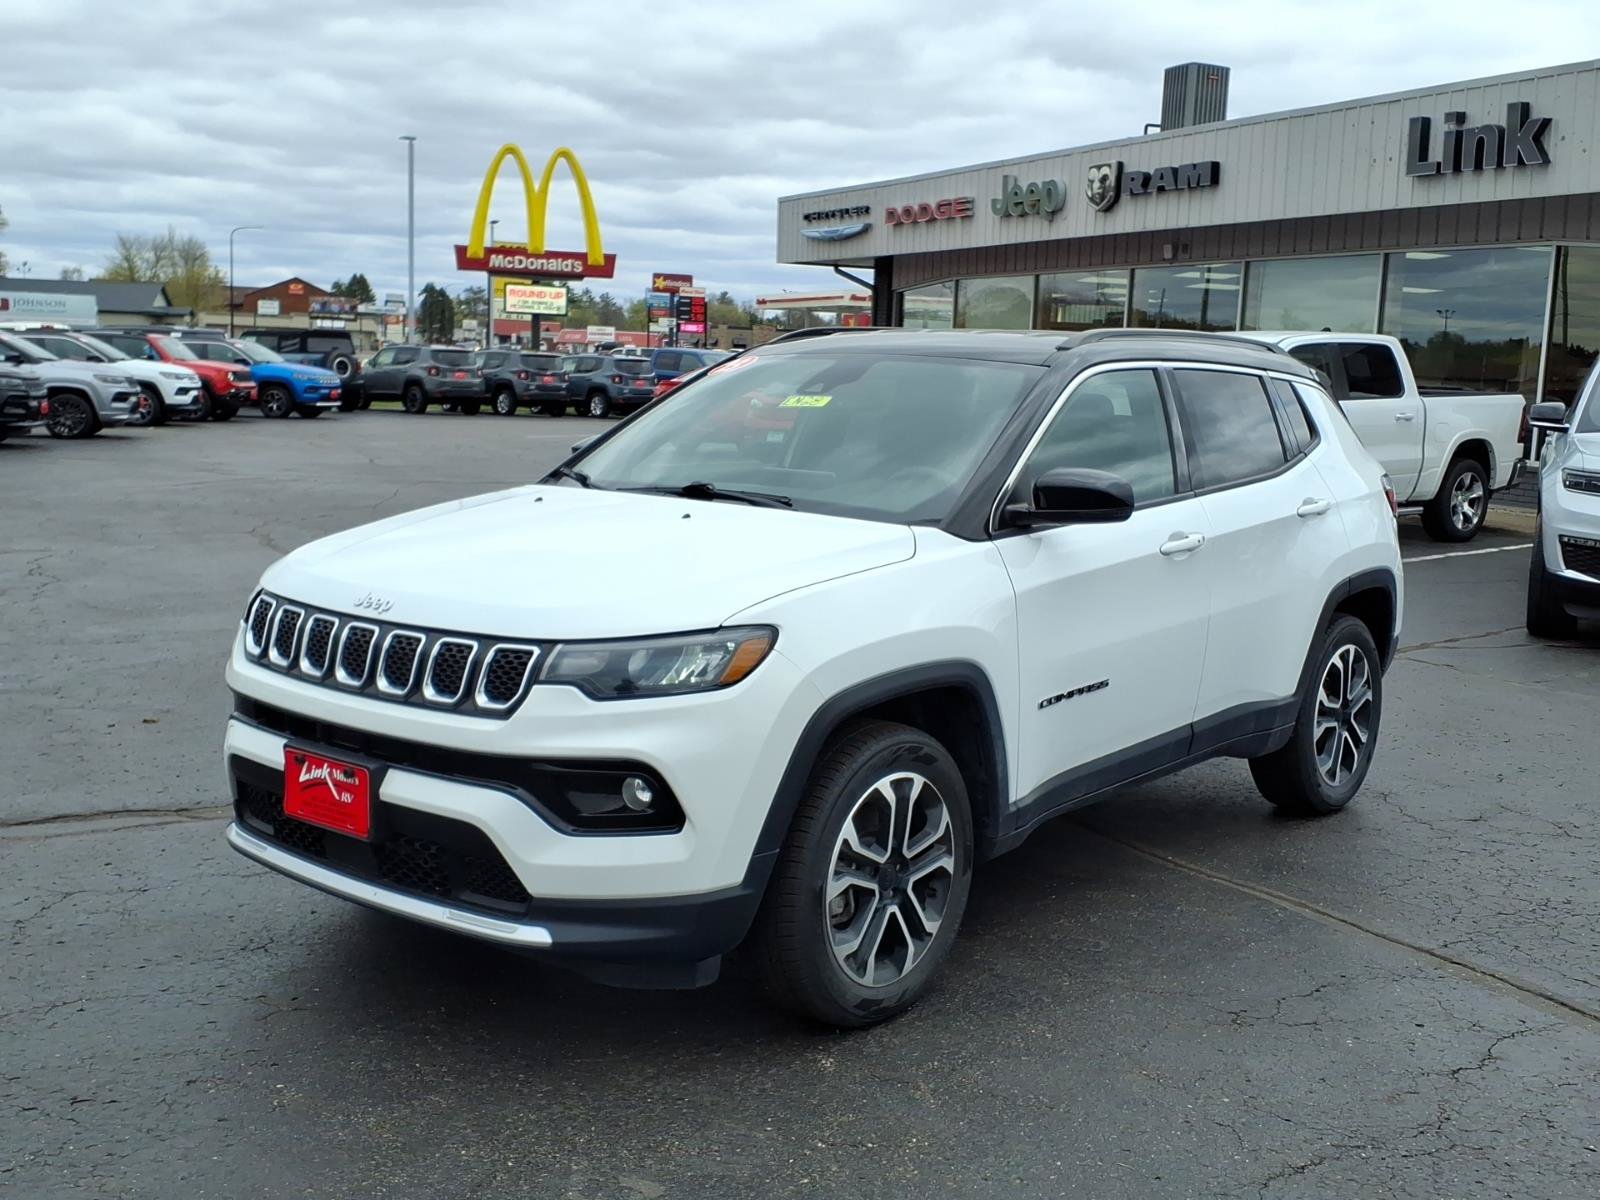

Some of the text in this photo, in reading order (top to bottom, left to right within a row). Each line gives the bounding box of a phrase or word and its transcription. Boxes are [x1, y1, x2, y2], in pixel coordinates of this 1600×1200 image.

[1406, 101, 1553, 177] Link
[1121, 160, 1220, 197] RAM
[884, 196, 976, 225] DODGE
[991, 175, 1066, 222] Jeep
[489, 254, 583, 273] McDonald's
[12, 298, 67, 309] JOHNSON
[509, 288, 546, 299] ROUND
[549, 291, 564, 300] UP
[353, 592, 394, 615] Jeep
[299, 761, 340, 801] Link
[341, 792, 354, 803] RV
